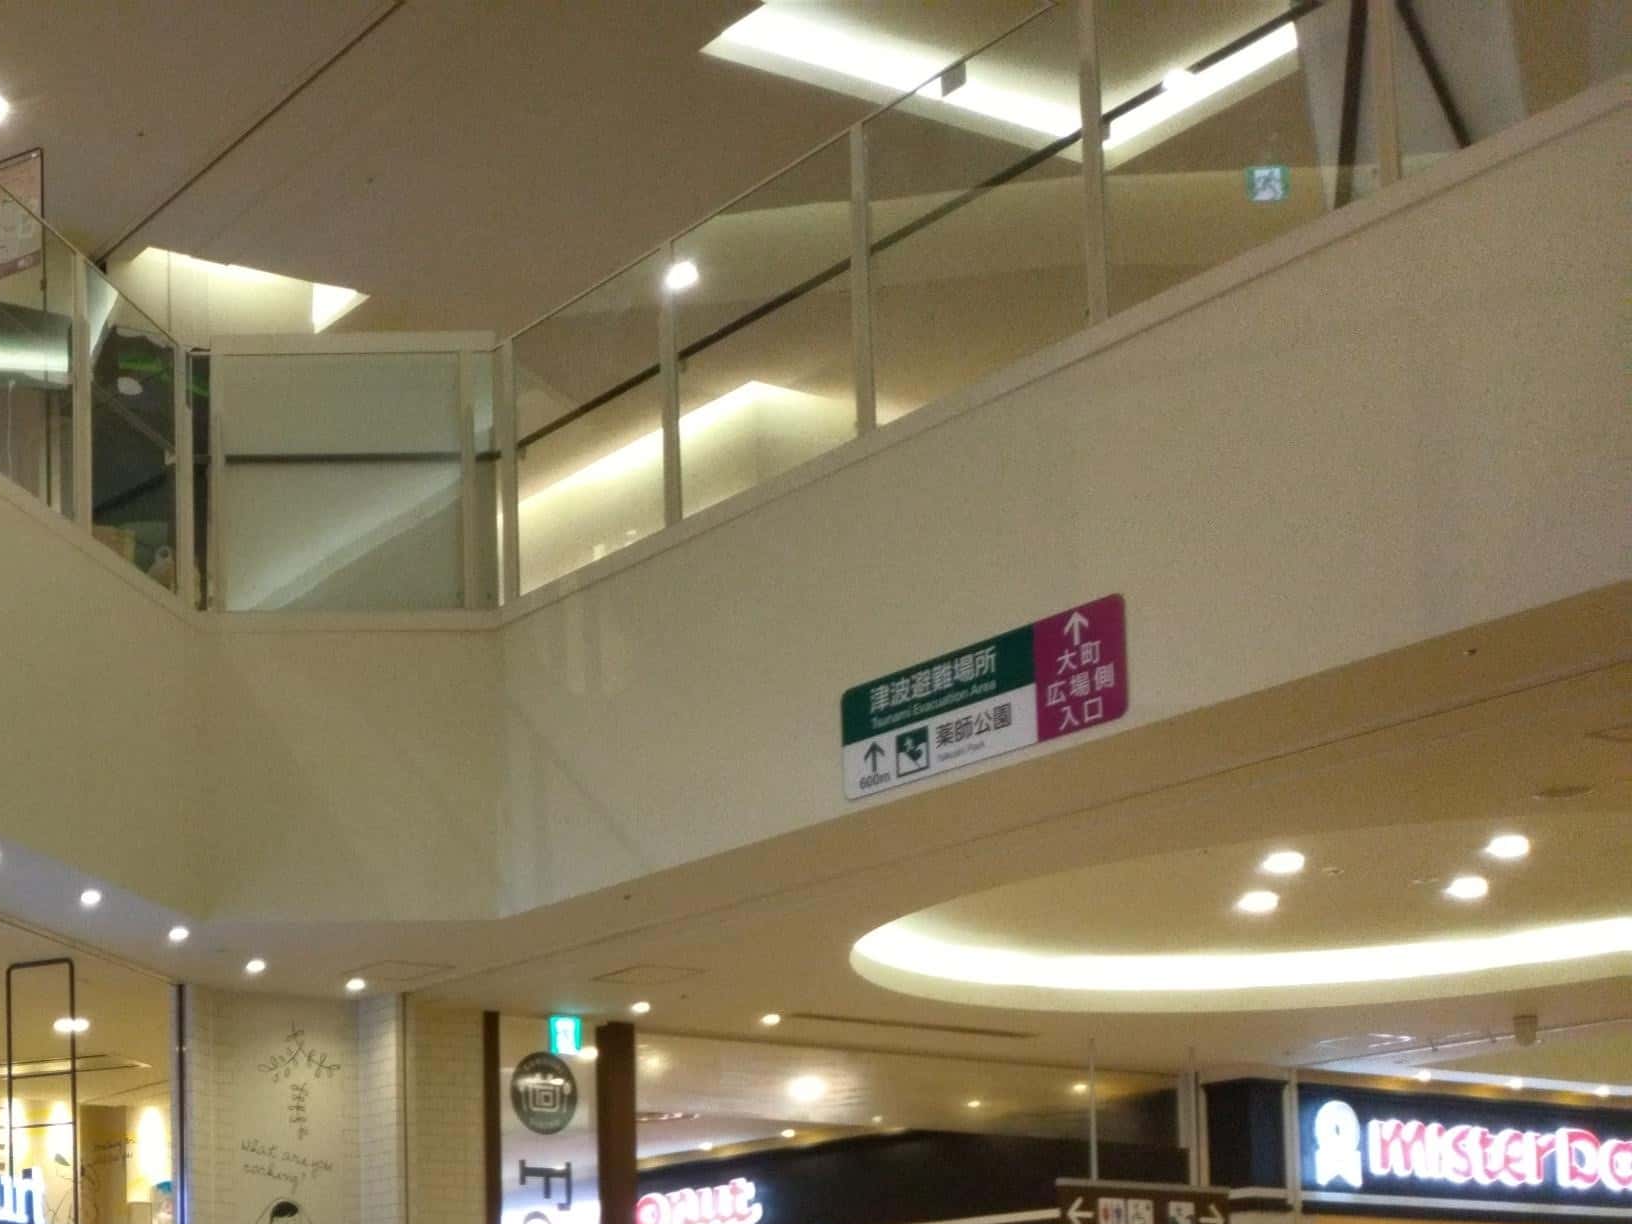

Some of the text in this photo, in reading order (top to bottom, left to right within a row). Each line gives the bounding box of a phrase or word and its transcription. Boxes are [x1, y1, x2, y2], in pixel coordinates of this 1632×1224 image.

[1056, 640, 1102, 675] 大町
[870, 645, 997, 714] 津波避難場所
[969, 679, 997, 698] Area
[1045, 662, 1115, 706] 広場側
[935, 702, 1013, 749] 薬師公園
[1058, 695, 1104, 731] 入口
